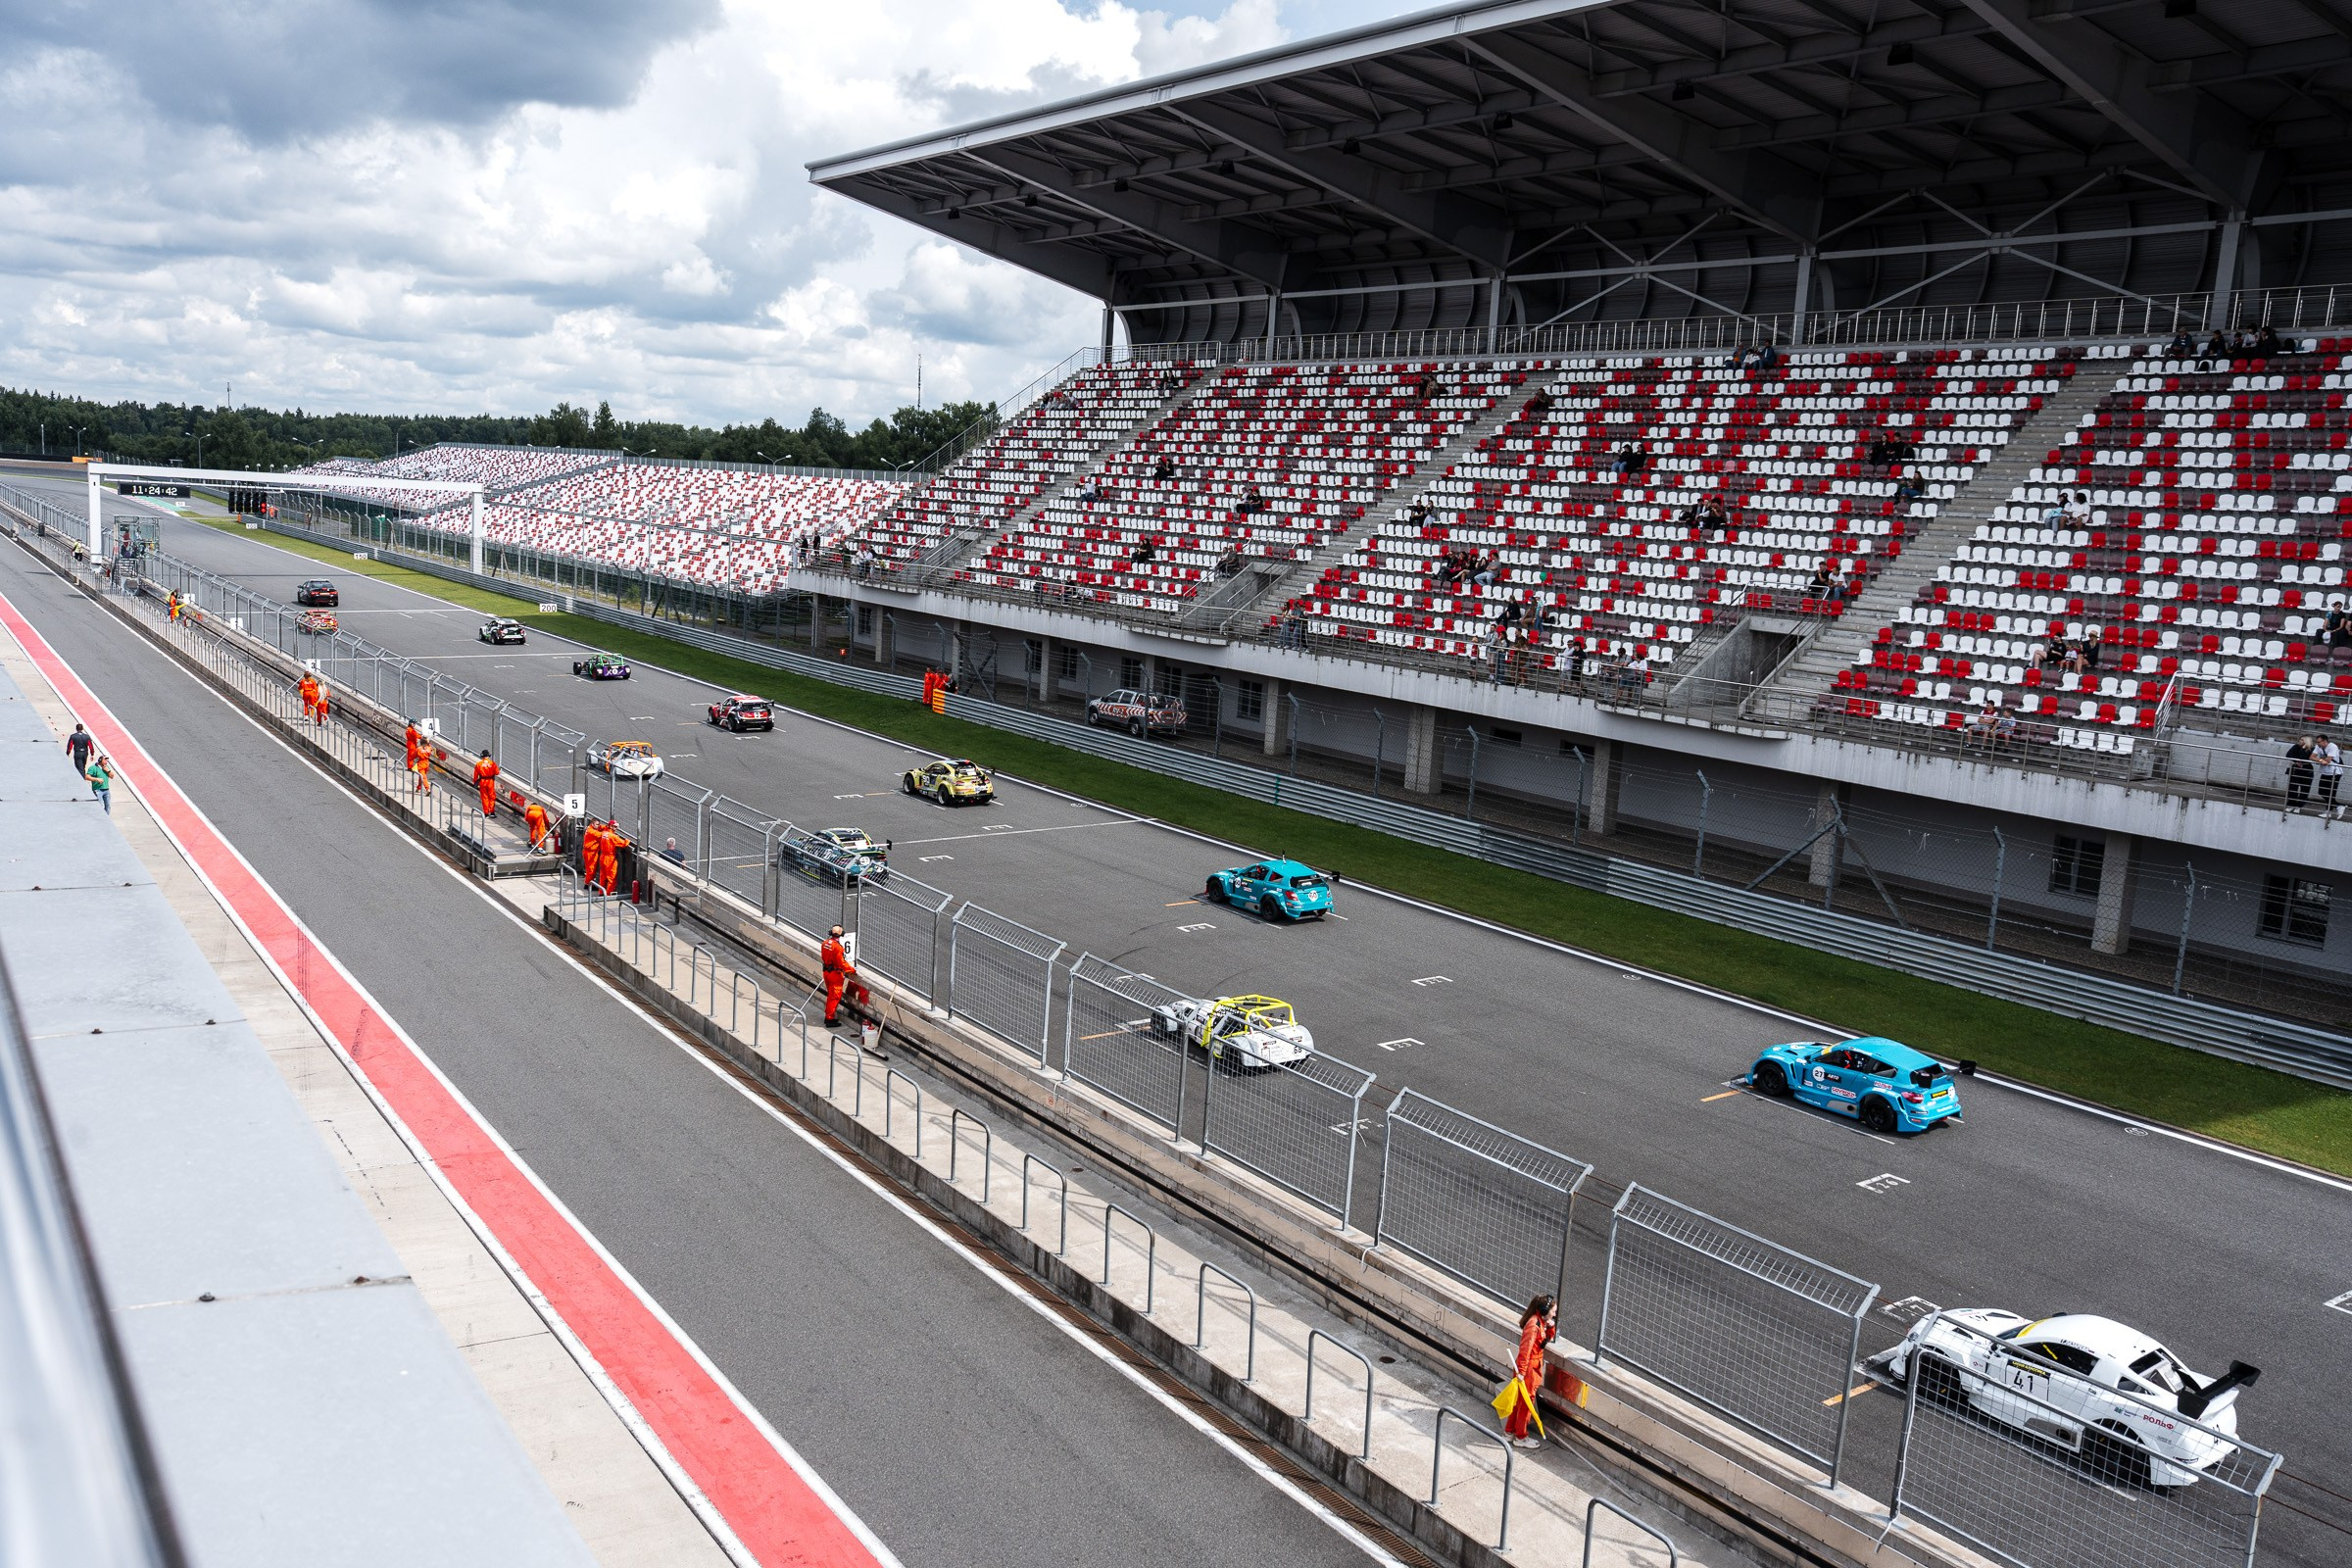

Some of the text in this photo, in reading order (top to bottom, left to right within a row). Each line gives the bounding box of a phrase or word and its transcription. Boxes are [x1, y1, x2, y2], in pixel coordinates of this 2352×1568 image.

[132, 485, 177, 496] 11:24:42
[541, 604, 556, 612] 200
[428, 722, 434, 731] 4
[571, 799, 578, 809] 5
[844, 941, 851, 955] 6
[1814, 1069, 1824, 1078] 27
[1876, 1179, 1898, 1189] 26
[2014, 1370, 2034, 1393] 41
[2142, 1414, 2175, 1431] РОЛЬФ
